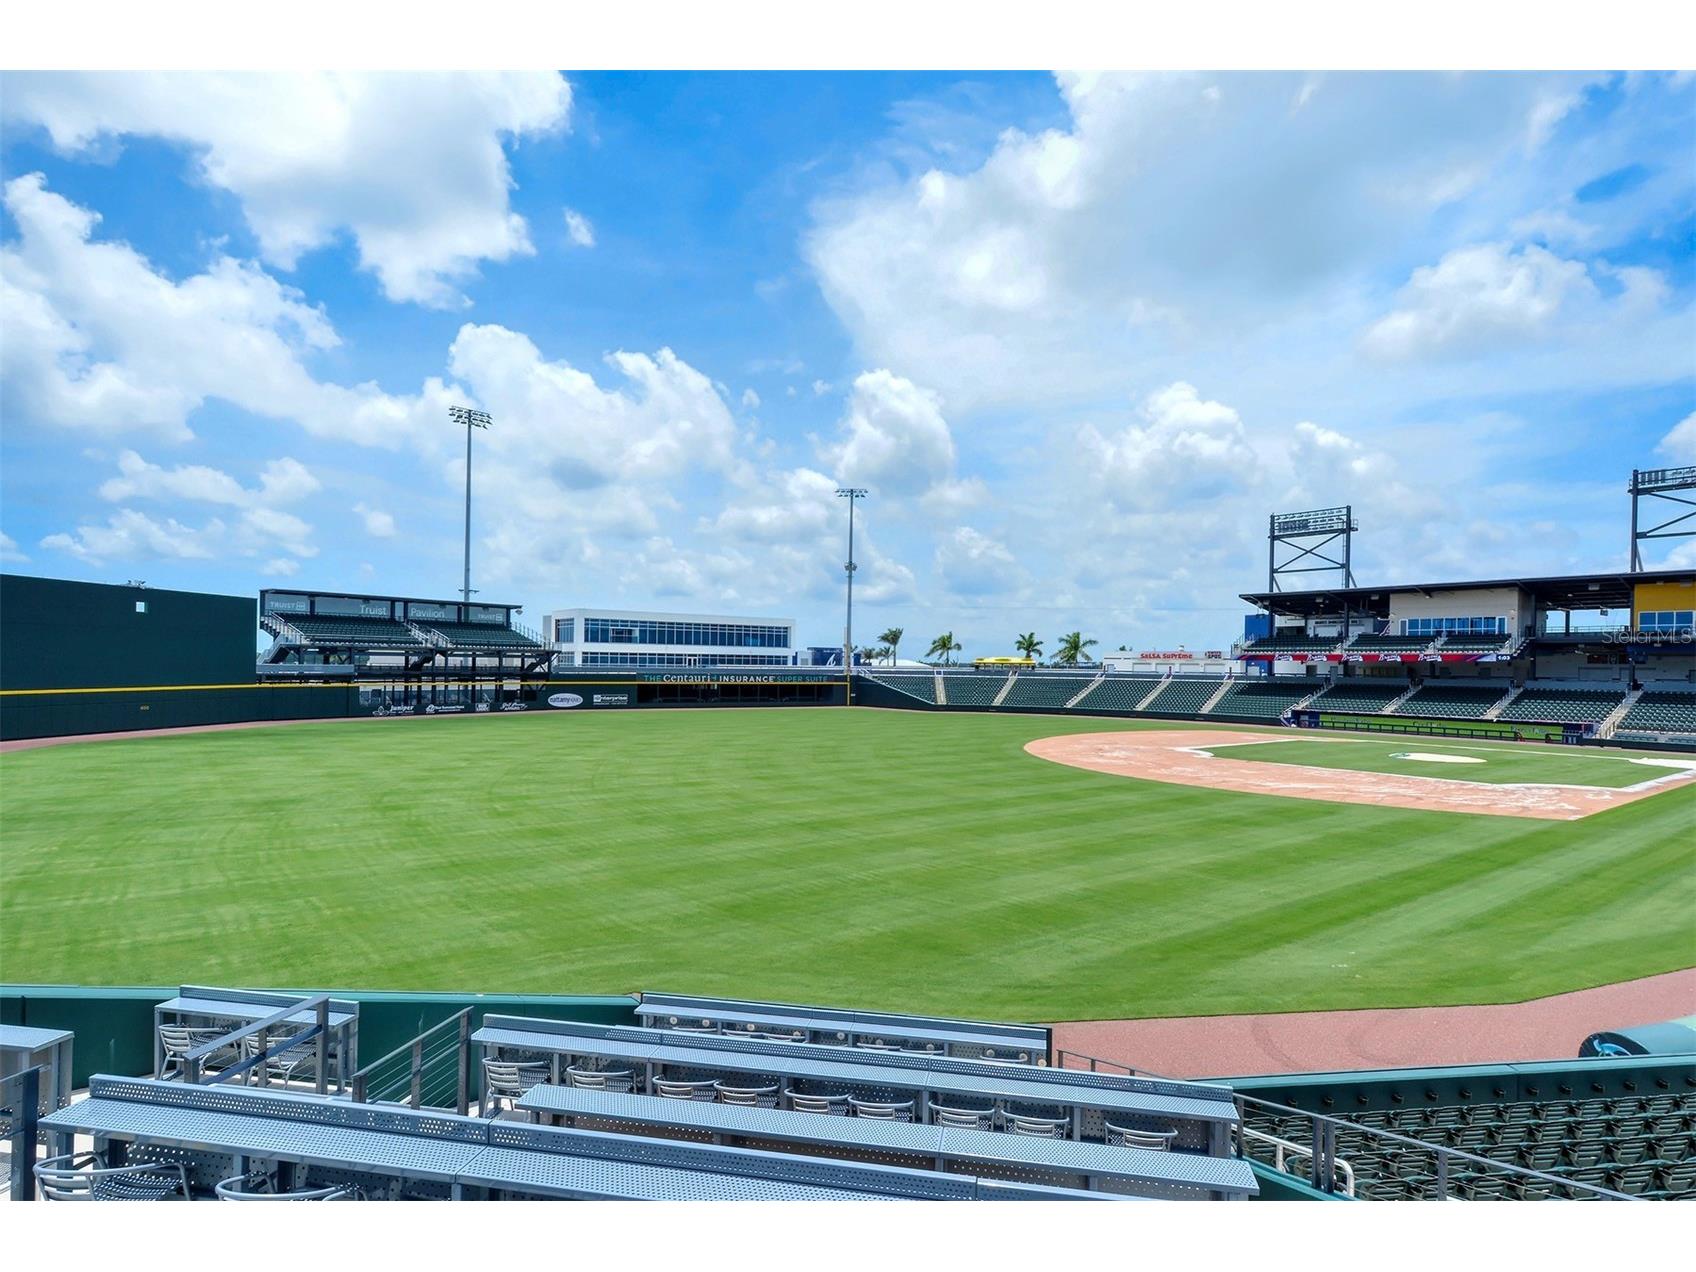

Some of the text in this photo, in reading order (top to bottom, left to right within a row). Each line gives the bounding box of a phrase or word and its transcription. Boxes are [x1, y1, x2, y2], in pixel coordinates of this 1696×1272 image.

[360, 604, 445, 619] Truist Pavilion
[644, 674, 661, 682] THE
